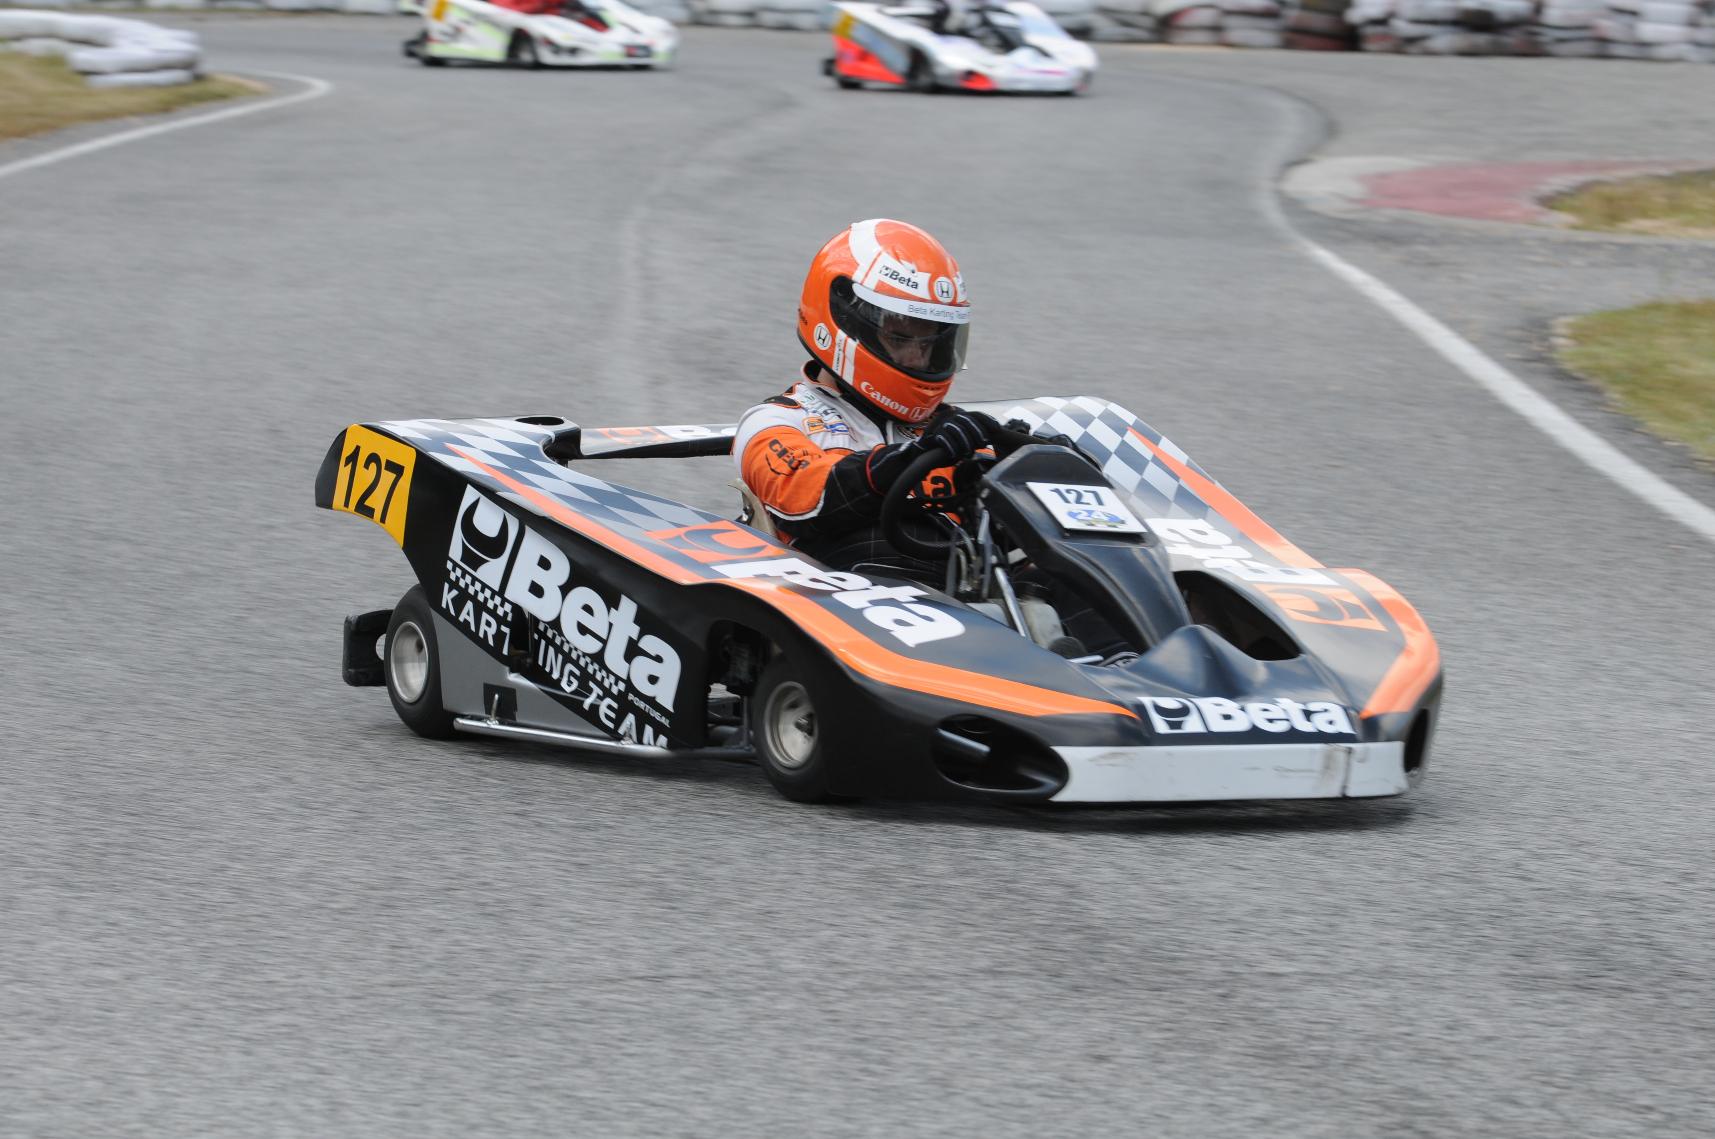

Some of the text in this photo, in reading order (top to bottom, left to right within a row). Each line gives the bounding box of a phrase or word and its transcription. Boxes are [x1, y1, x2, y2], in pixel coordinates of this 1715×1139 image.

[889, 269, 919, 290] Beta
[907, 304, 928, 315] Beta
[860, 381, 910, 415] Canon
[343, 445, 405, 525] 127
[1048, 487, 1105, 506] 127
[1145, 518, 1341, 586] Beta
[503, 524, 682, 713] Beta
[627, 692, 671, 728] PORTUGAL
[1200, 696, 1358, 735] Beta
